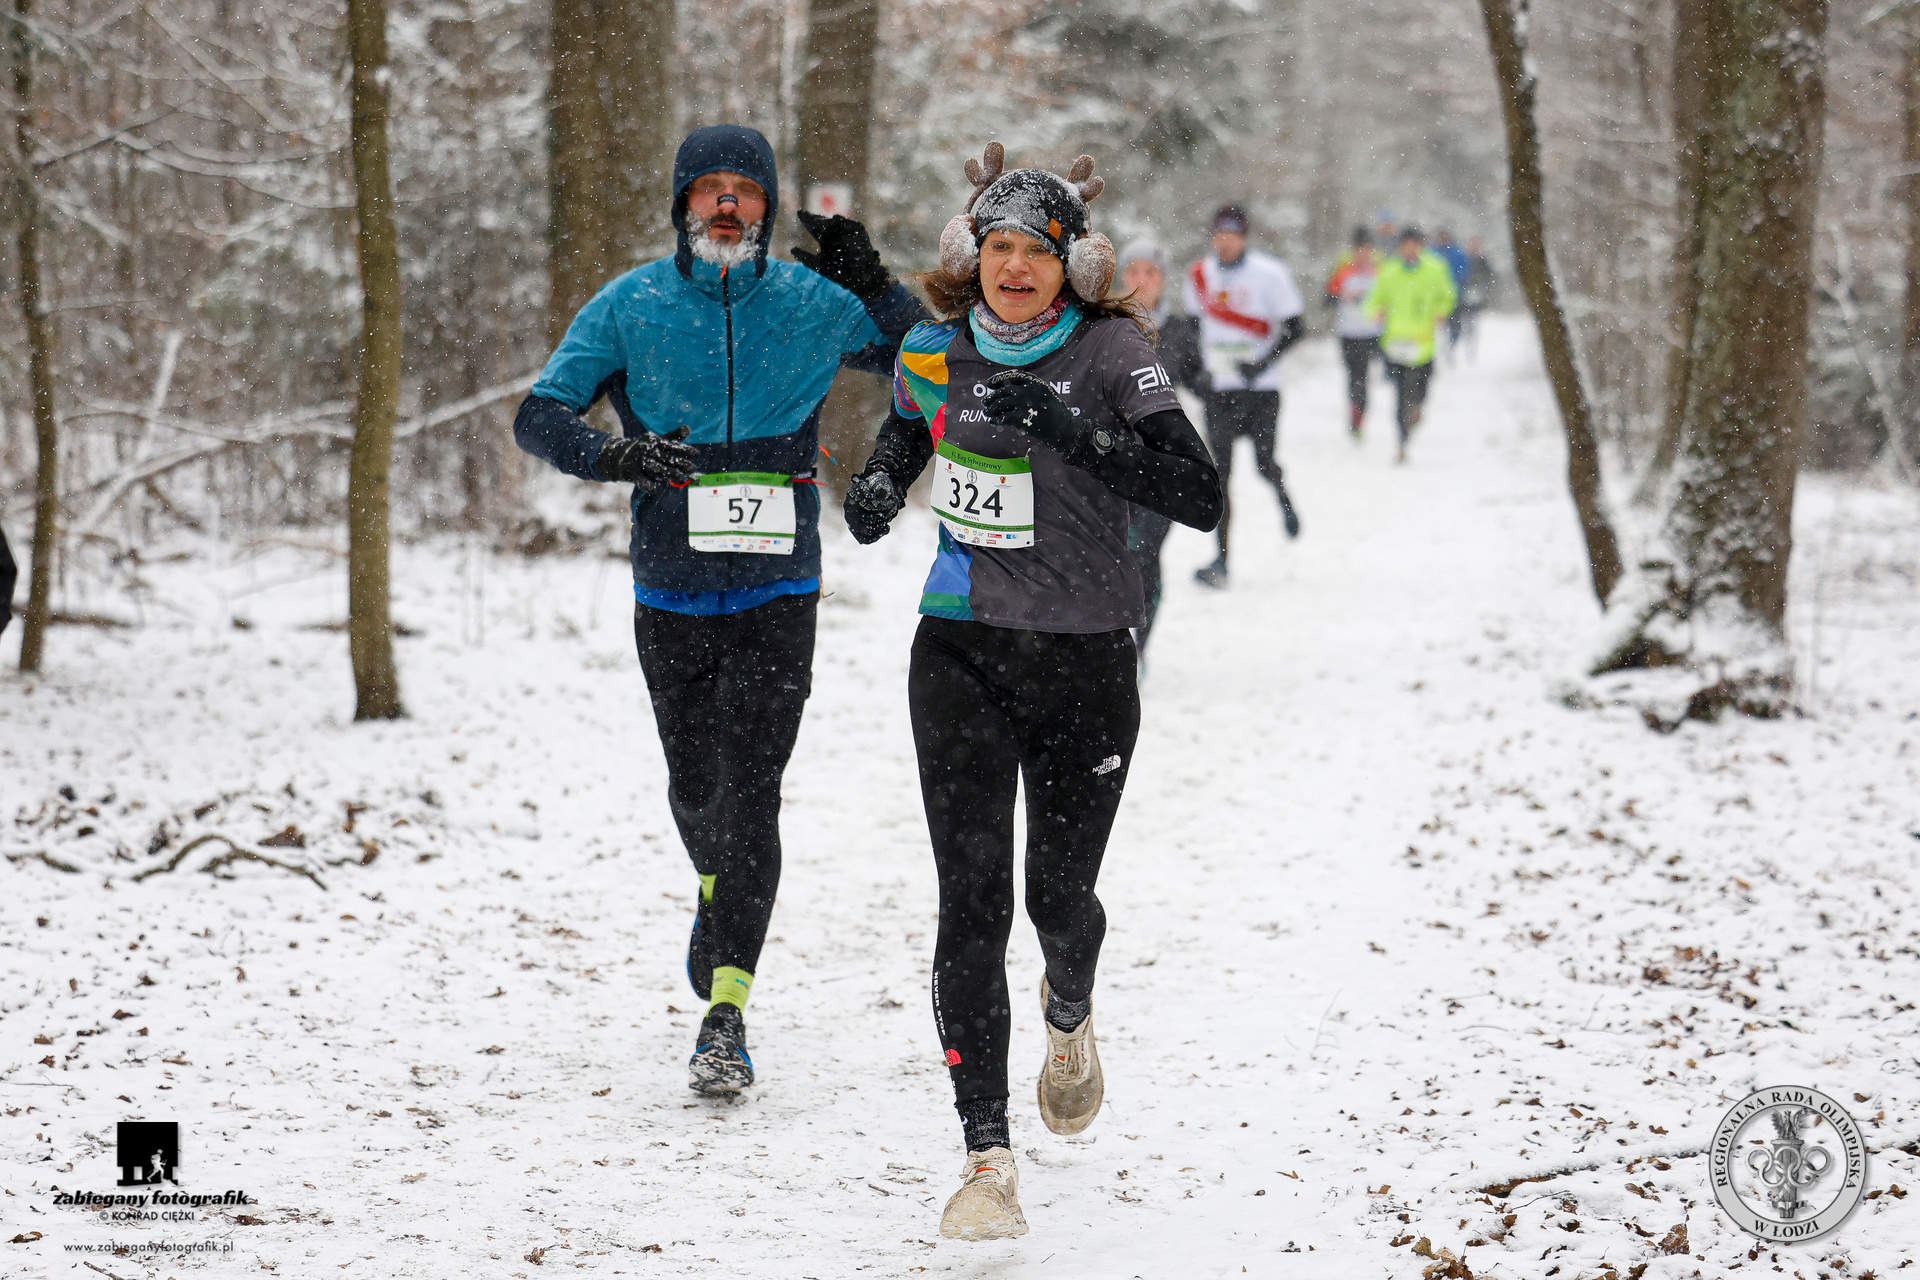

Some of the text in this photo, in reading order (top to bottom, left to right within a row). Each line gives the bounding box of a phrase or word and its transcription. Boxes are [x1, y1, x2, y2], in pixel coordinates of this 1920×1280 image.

[967, 456, 1001, 471] Sylwestrowy
[949, 477, 1004, 518] 324
[728, 498, 763, 524] 57
[937, 1010, 946, 1036] STOP
